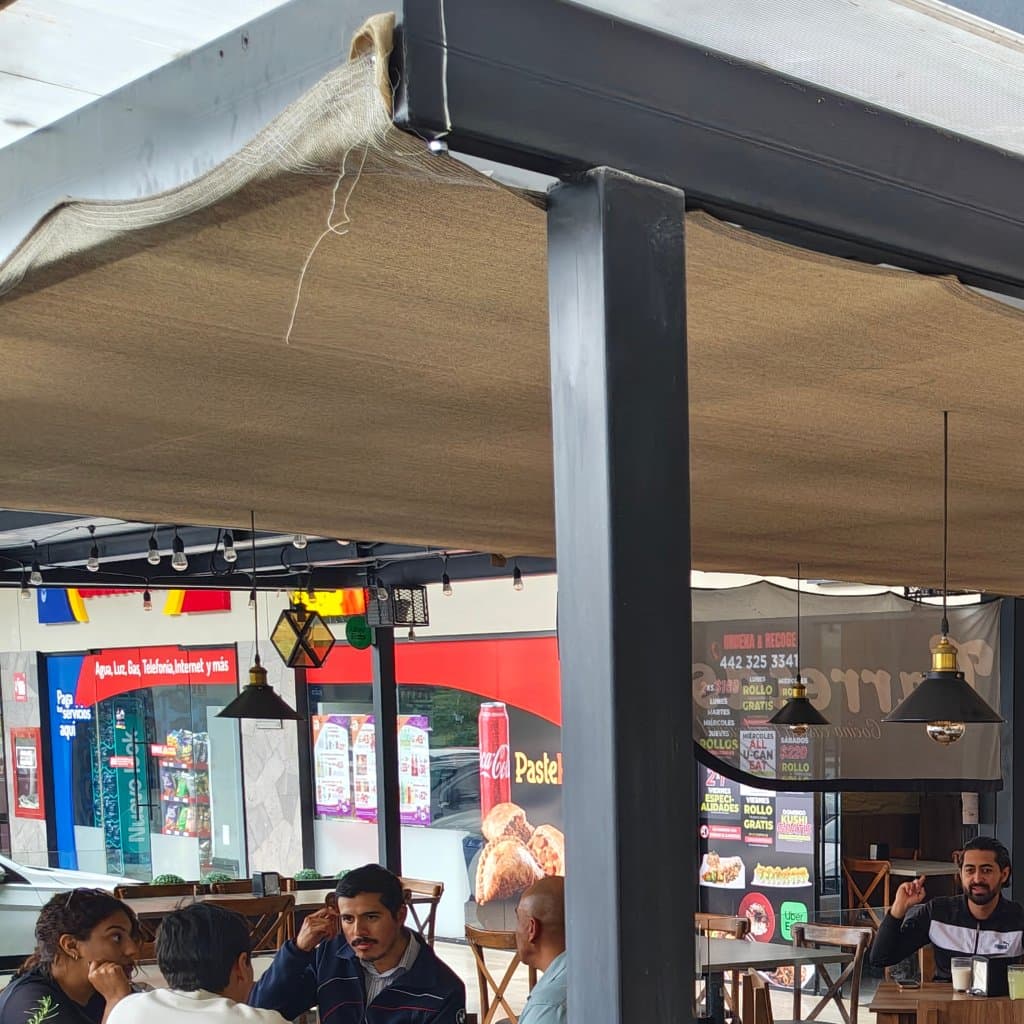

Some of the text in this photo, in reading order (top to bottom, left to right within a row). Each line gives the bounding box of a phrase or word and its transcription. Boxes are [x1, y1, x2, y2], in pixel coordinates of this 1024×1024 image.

[720, 654, 798, 669] 442 325 3341
[95, 664, 113, 680] Agua,
[113, 660, 127, 676] Luz,
[127, 660, 141, 677] Gas,
[175, 659, 204, 674] Internet
[205, 664, 212, 677] y
[213, 656, 229, 672] más
[743, 684, 773, 696] ROLLO
[56, 689, 73, 706] Paga
[743, 700, 774, 711] GRATIS
[62, 705, 92, 720] servicios
[59, 721, 76, 740] aquí
[700, 739, 738, 750] ROLLOS
[749, 739, 767, 749] ALL
[743, 750, 773, 760] U-CAN
[749, 761, 767, 771] EAT
[782, 762, 810, 772] ROLLO
[705, 793, 734, 803] ESPECI-
[701, 802, 739, 813] ALIDADES
[744, 805, 773, 815] ROLLO
[744, 819, 774, 831] GRATIS
[781, 815, 808, 824] KUSHI
